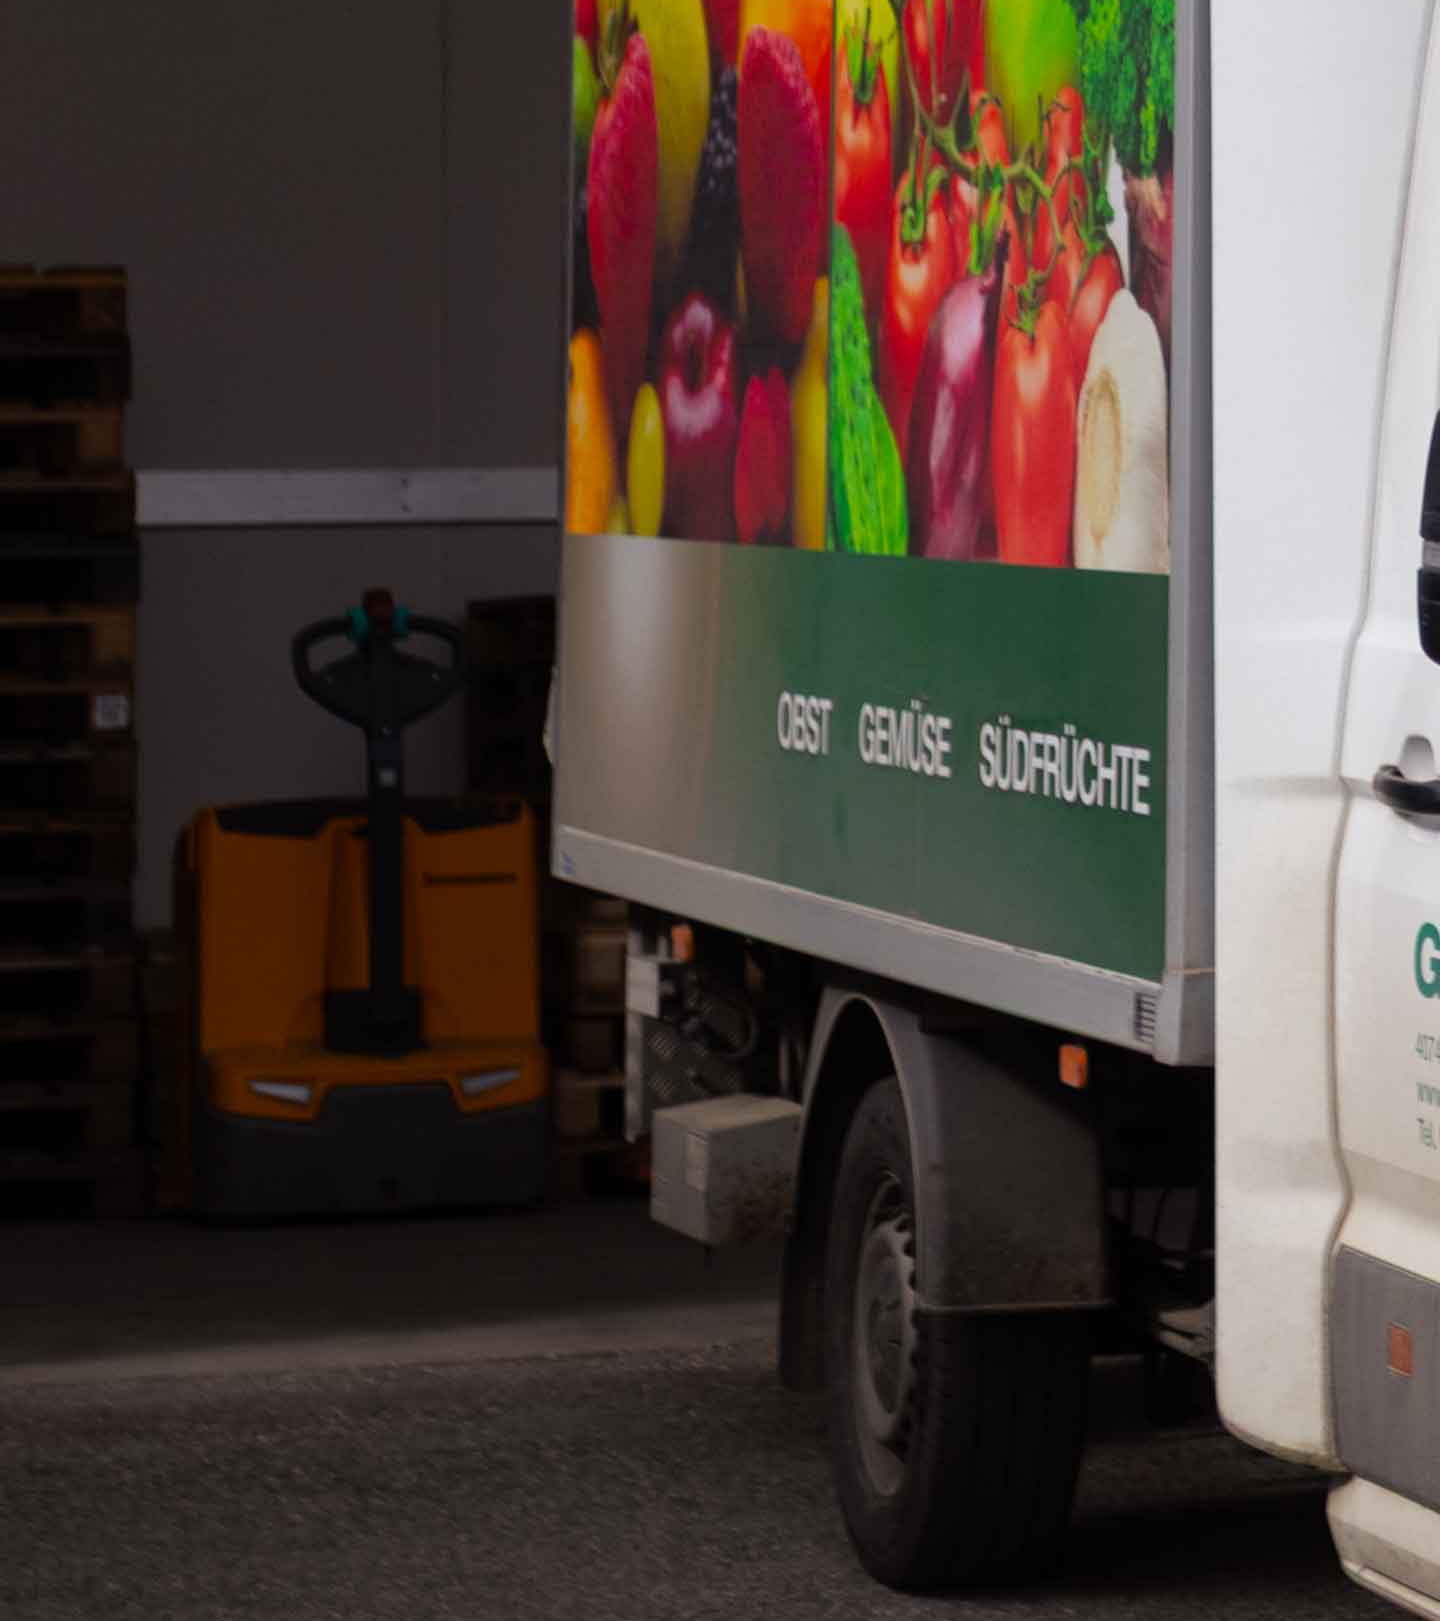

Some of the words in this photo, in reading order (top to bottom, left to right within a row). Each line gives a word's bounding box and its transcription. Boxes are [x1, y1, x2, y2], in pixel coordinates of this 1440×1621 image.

[777, 692, 832, 756] OBST
[858, 699, 952, 778] GEMÜSE
[979, 715, 1151, 815] SÜDFRÜCHTE
